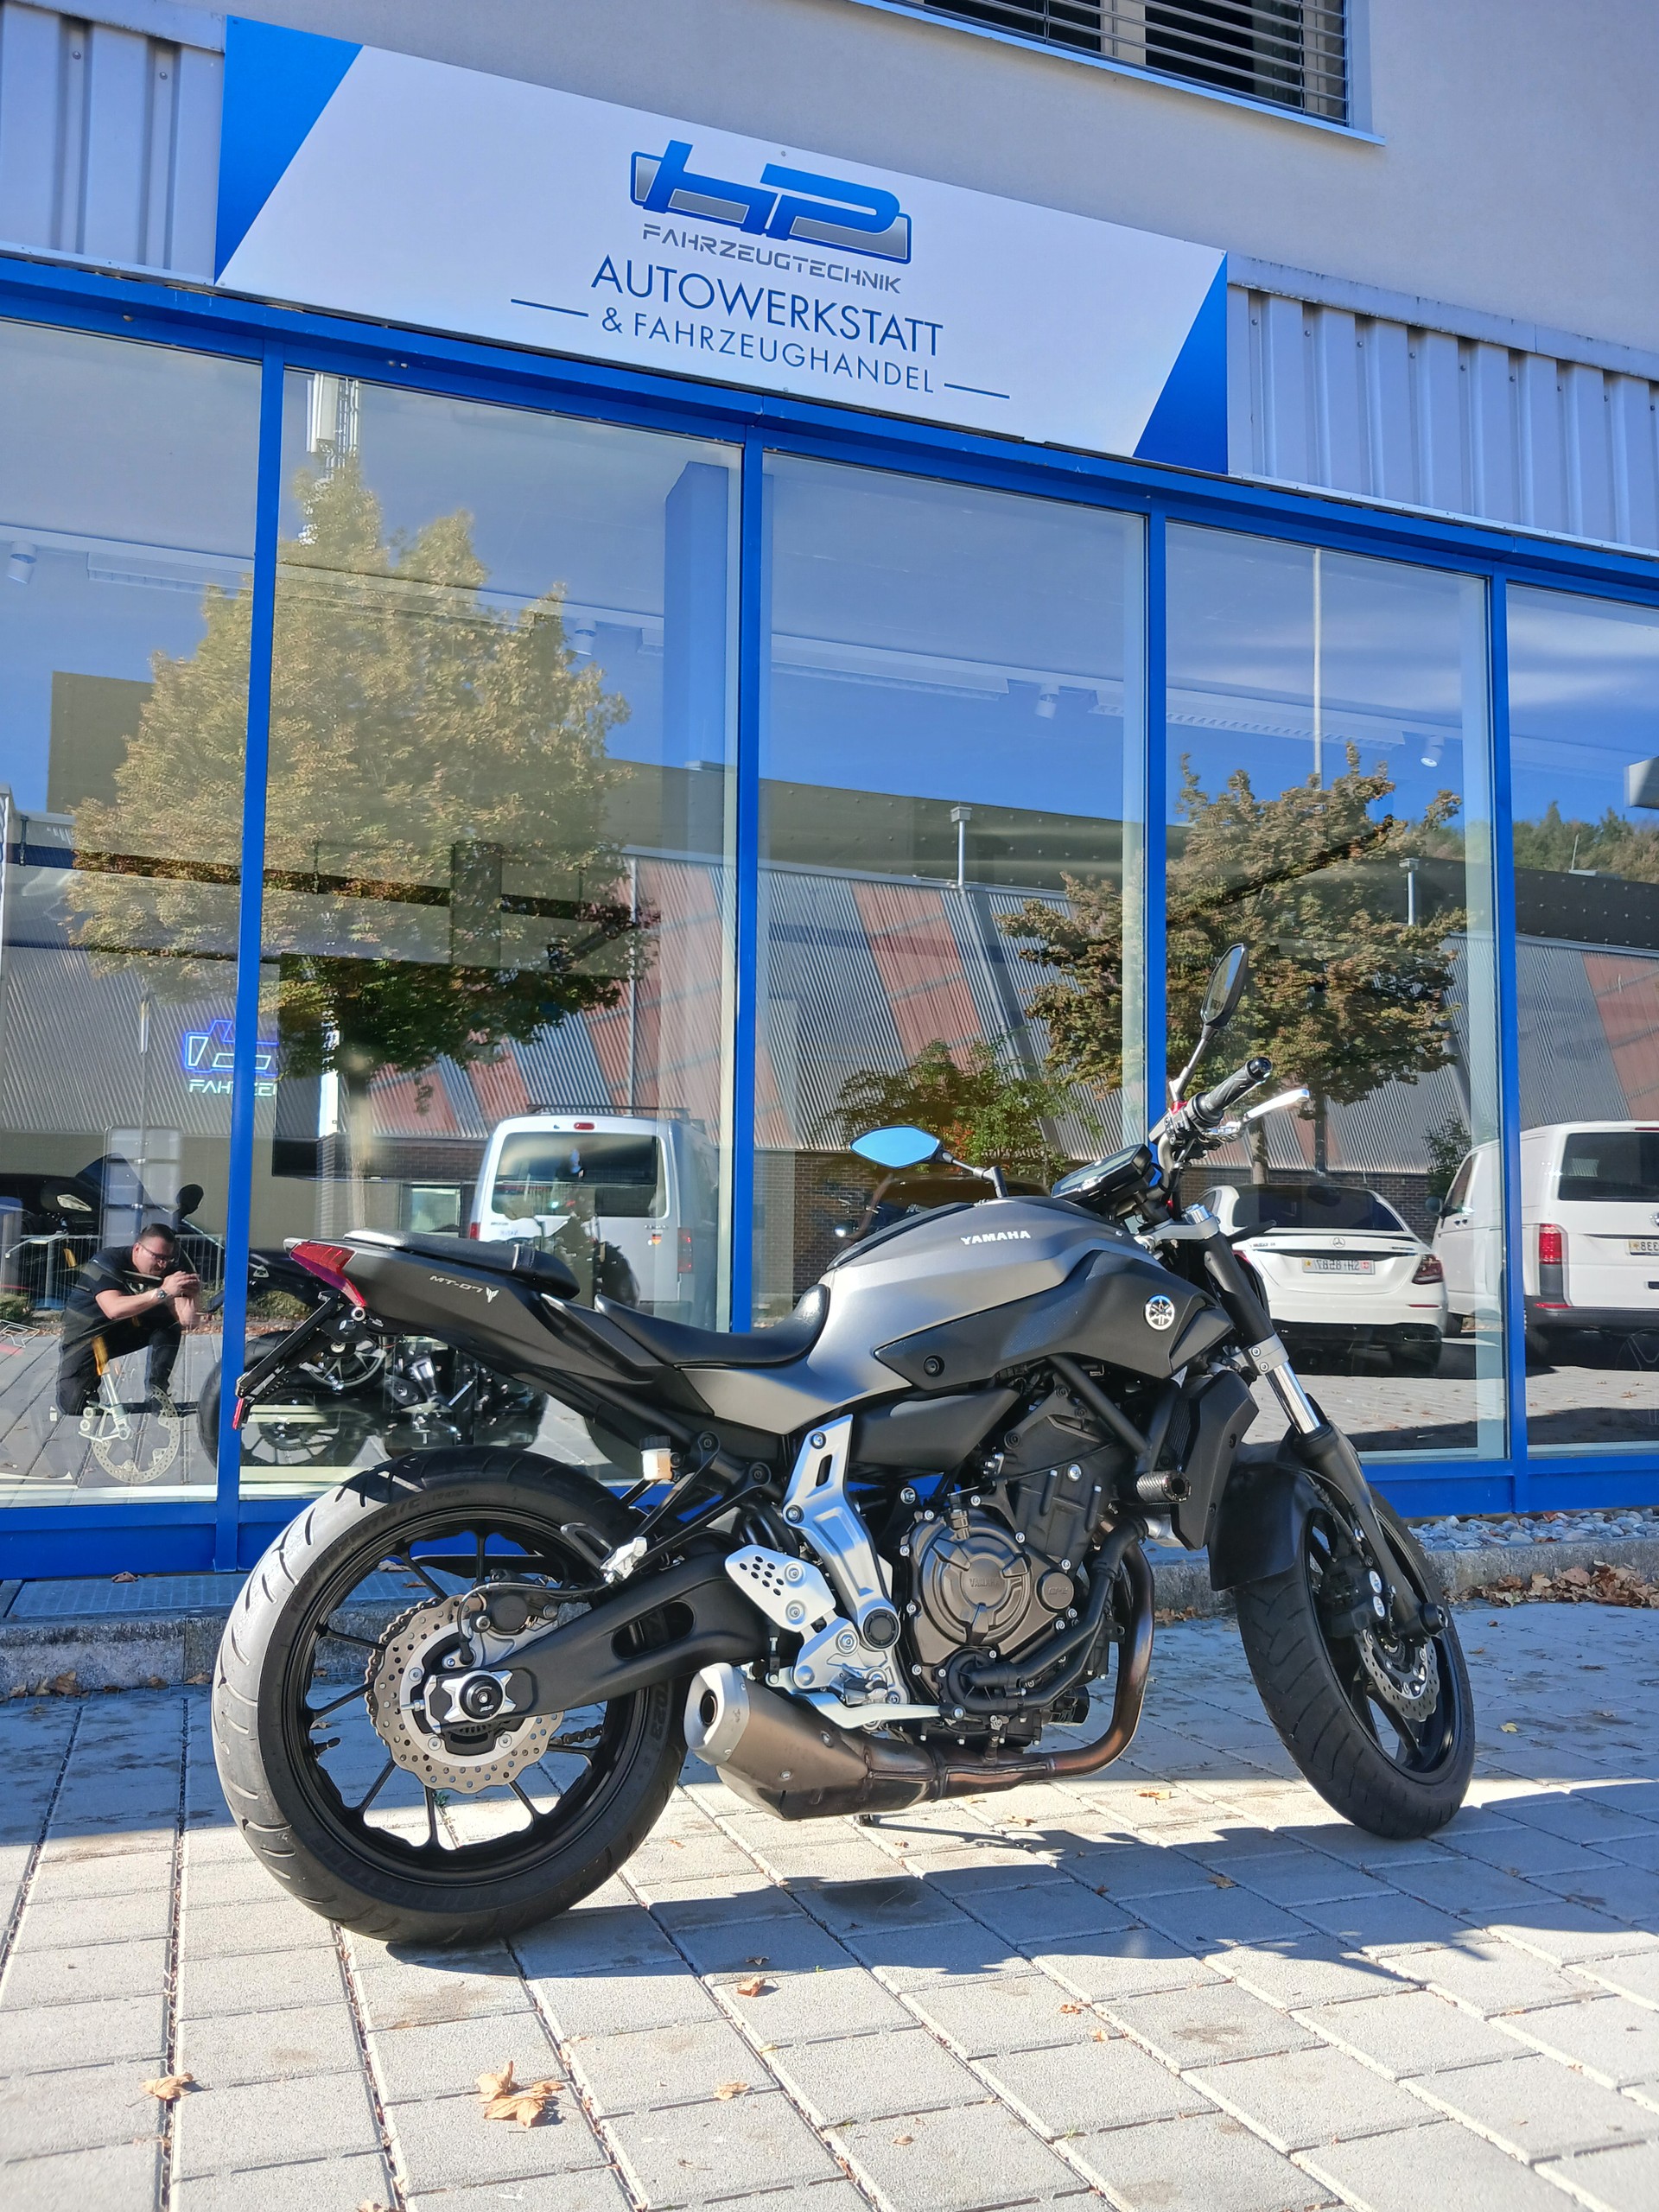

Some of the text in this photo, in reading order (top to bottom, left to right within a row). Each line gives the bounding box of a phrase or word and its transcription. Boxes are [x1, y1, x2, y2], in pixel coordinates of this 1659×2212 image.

[643, 224, 901, 294] FAHRZEUGTECHNIK
[591, 254, 944, 356] AUTOWERKSTATT
[601, 307, 934, 393] & FAHRZEUGHANDEL
[961, 1230, 1031, 1245] YAMAHA
[429, 1275, 483, 1293] MT-07
